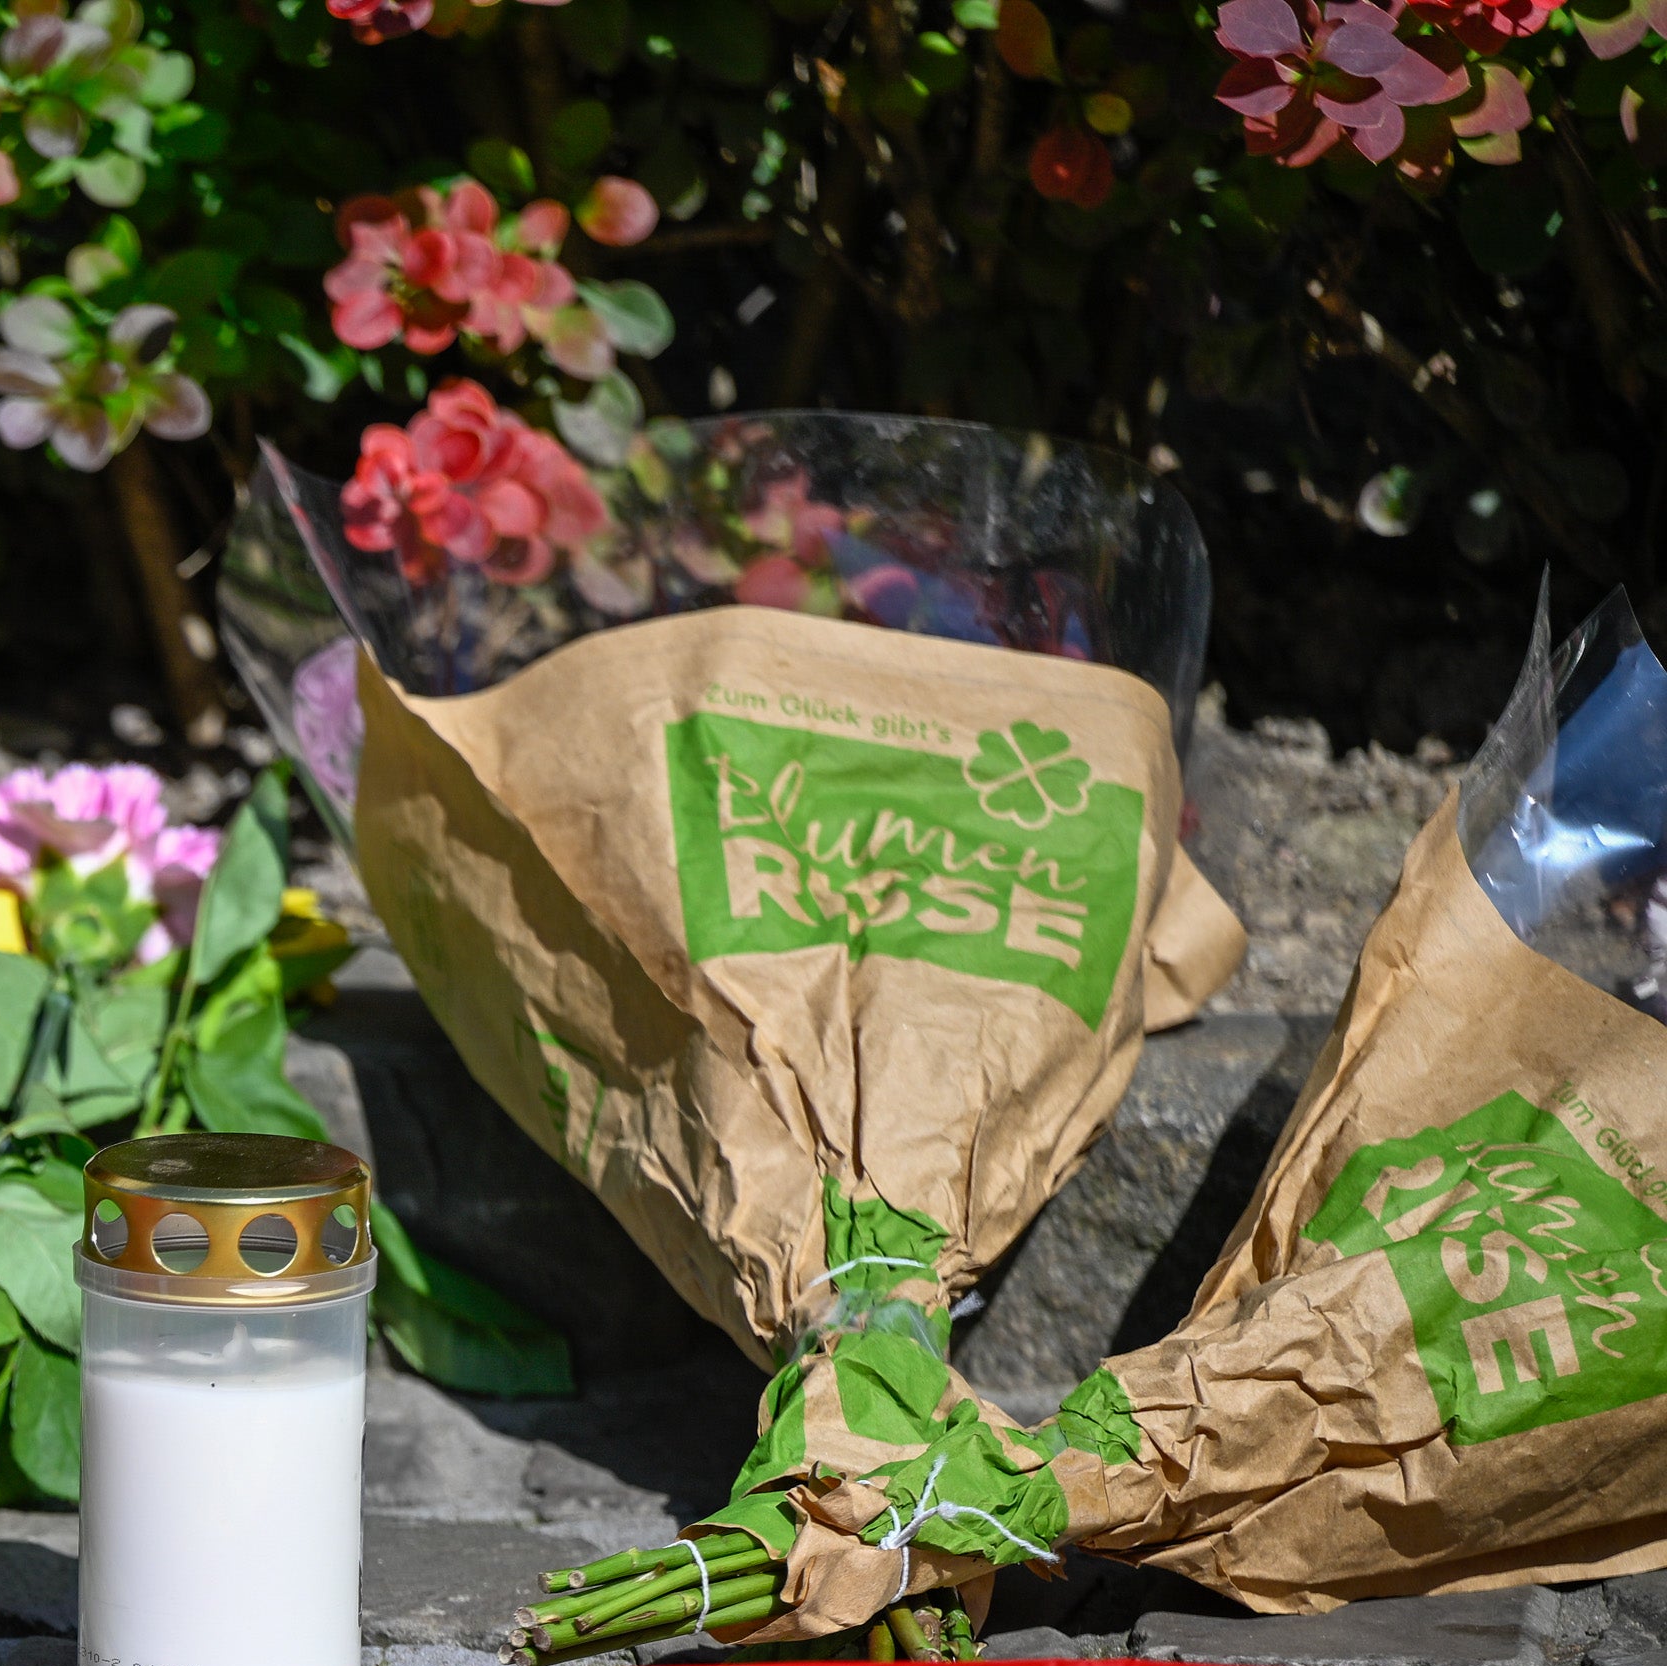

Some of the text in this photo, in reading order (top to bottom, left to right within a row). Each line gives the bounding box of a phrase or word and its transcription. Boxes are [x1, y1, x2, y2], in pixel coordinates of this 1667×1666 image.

[705, 682, 952, 745] Zum Glück gibt's
[706, 752, 1087, 893] Blumen
